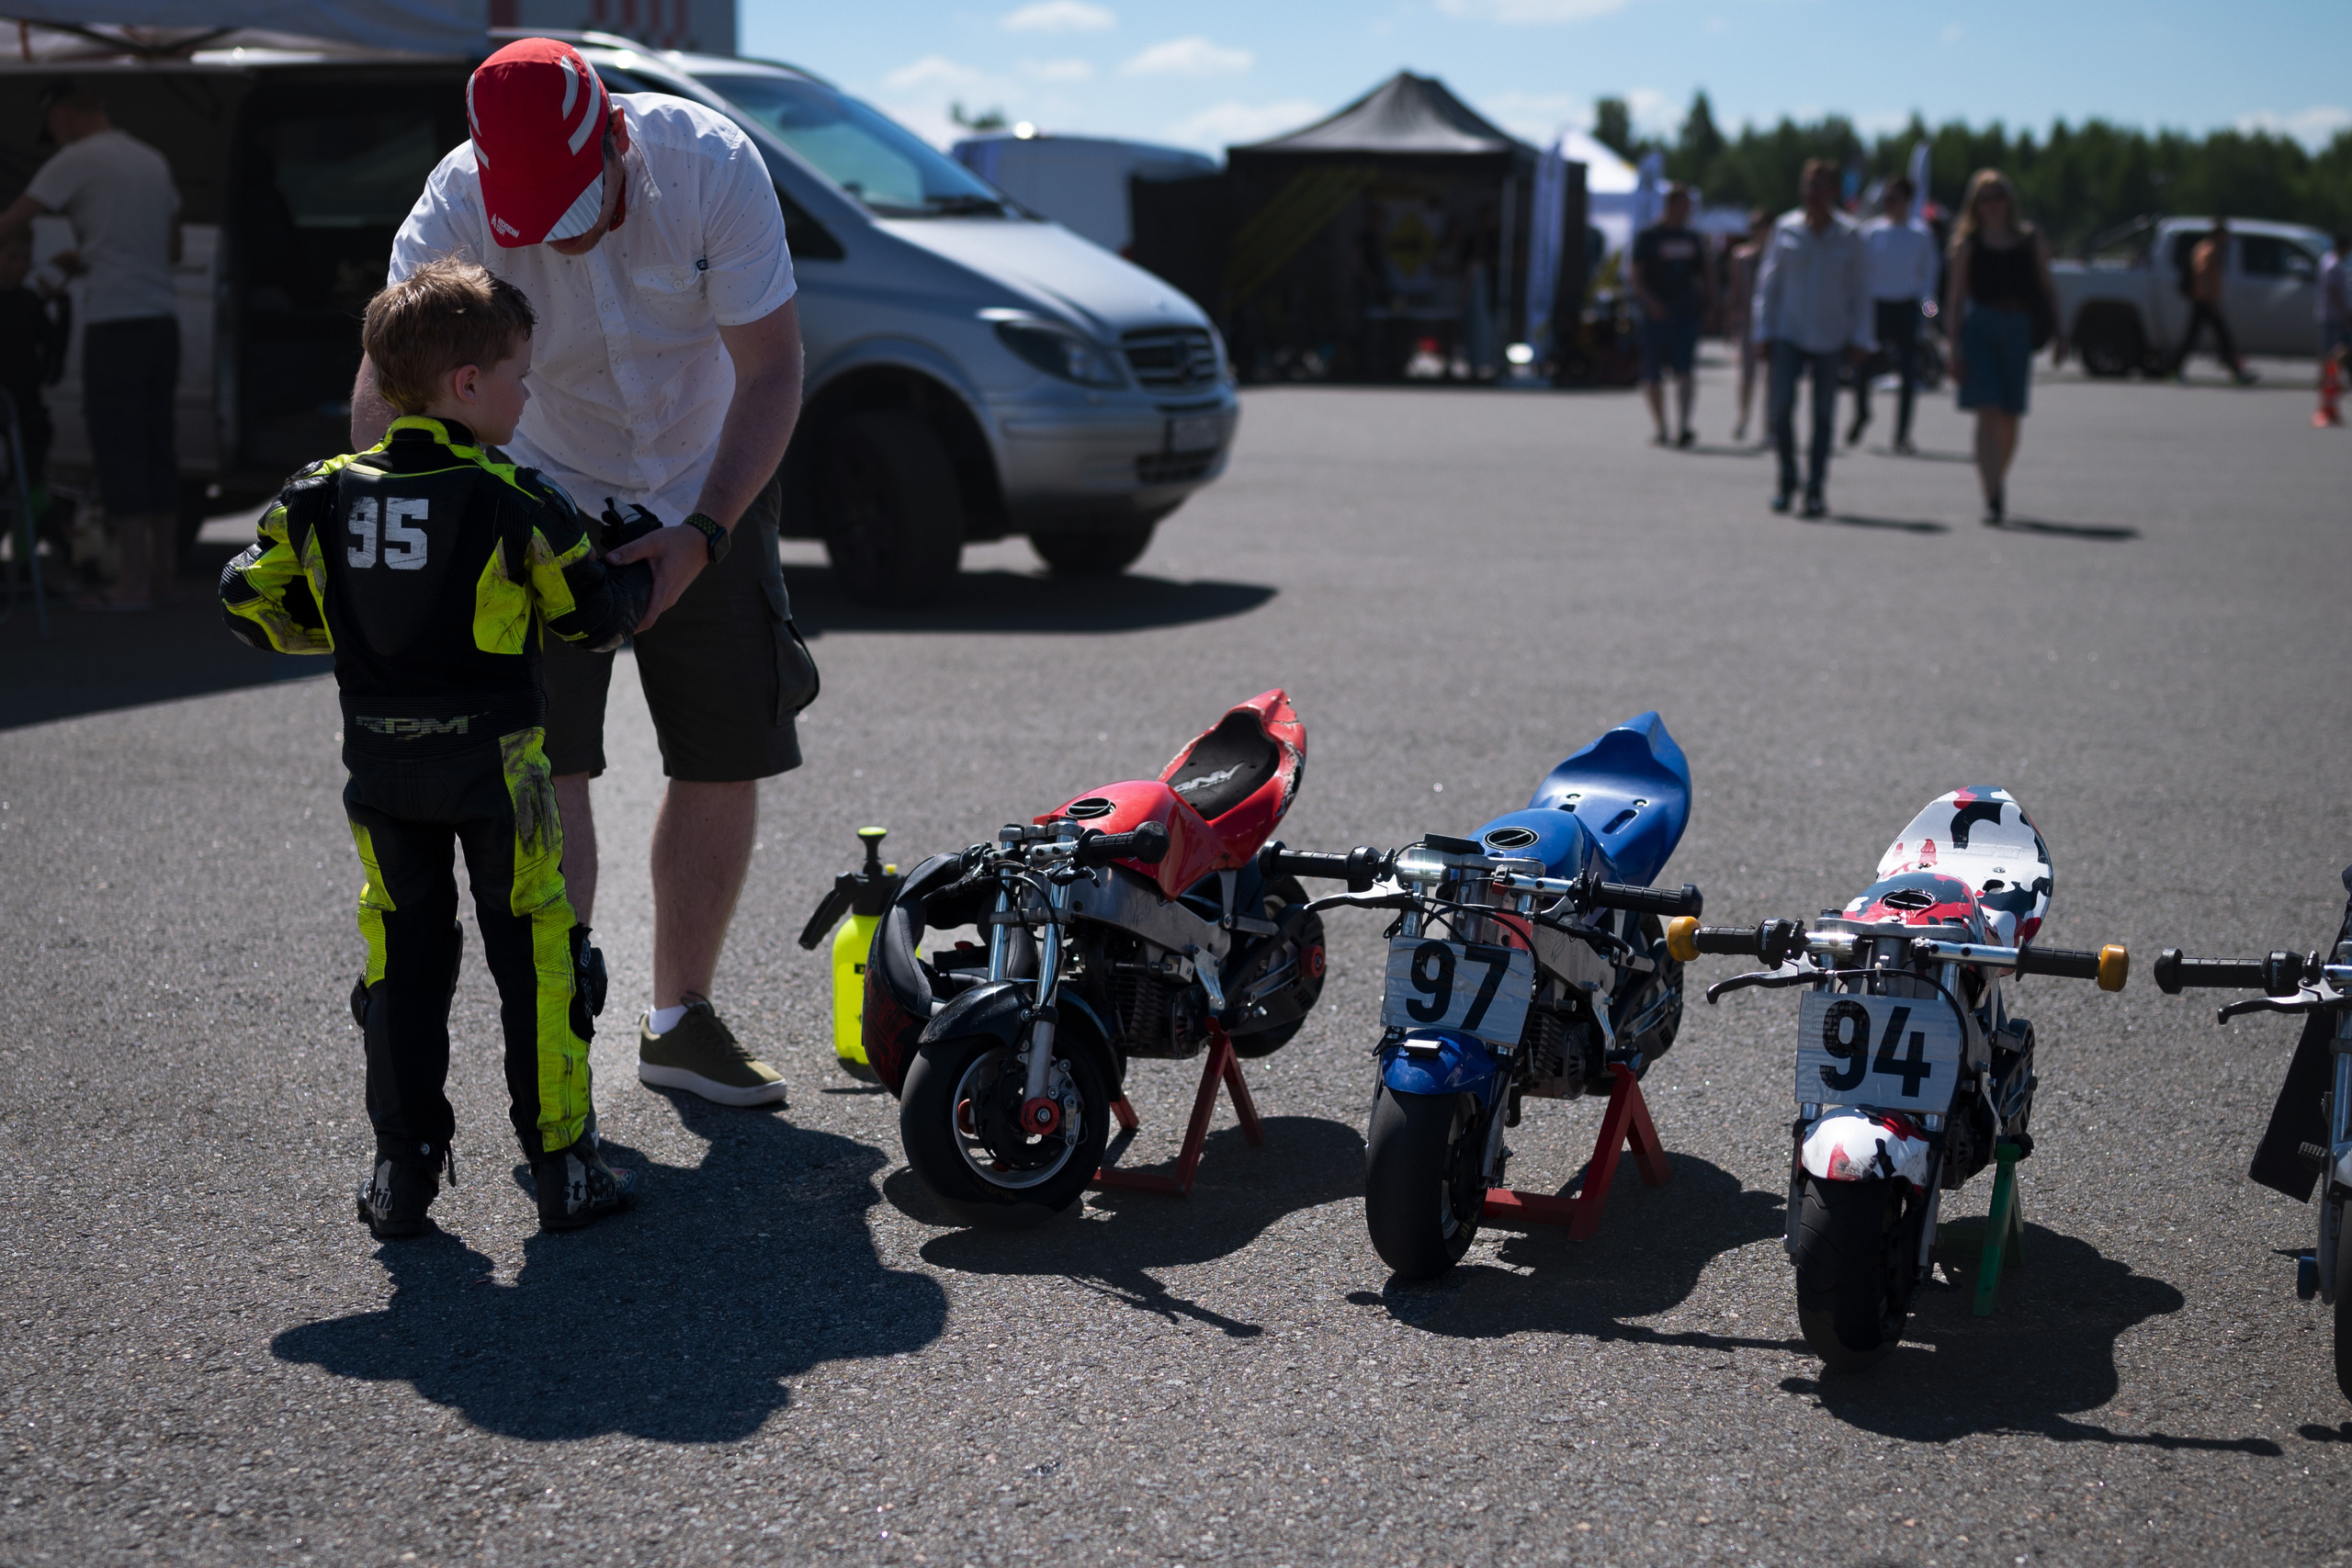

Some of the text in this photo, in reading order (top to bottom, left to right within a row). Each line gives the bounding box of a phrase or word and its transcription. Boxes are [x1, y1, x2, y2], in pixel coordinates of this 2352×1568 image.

[347, 496, 429, 570] 95
[1406, 941, 1511, 1032] 97
[1819, 999, 1932, 1098] 94
